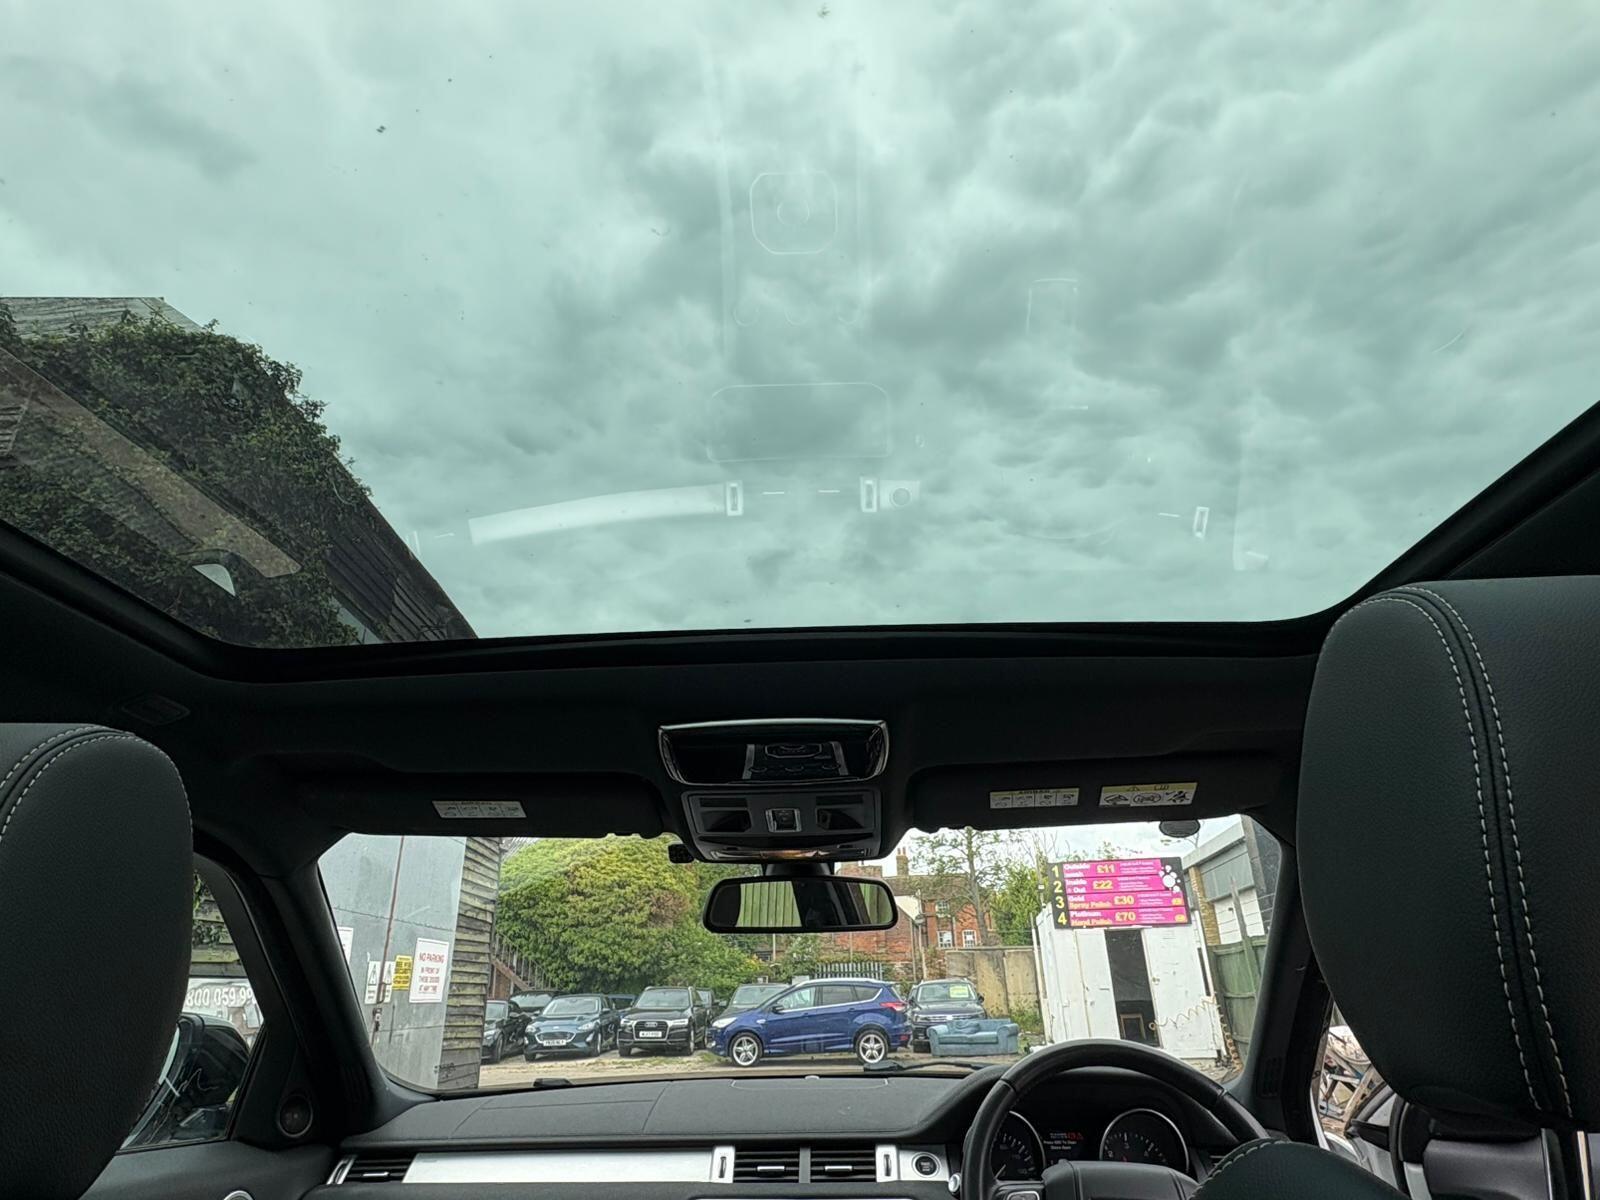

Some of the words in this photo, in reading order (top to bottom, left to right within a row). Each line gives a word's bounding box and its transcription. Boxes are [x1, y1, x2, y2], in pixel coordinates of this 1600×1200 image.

[1051, 865, 1059, 877] 1
[1097, 864, 1115, 874] £11
[1053, 880, 1063, 893] 2
[1093, 880, 1113, 890] £22
[1055, 896, 1065, 909] 3
[1113, 895, 1134, 905] £30
[1057, 911, 1068, 925] 4
[1115, 911, 1136, 922] £70
[214, 987, 236, 1006] 059
